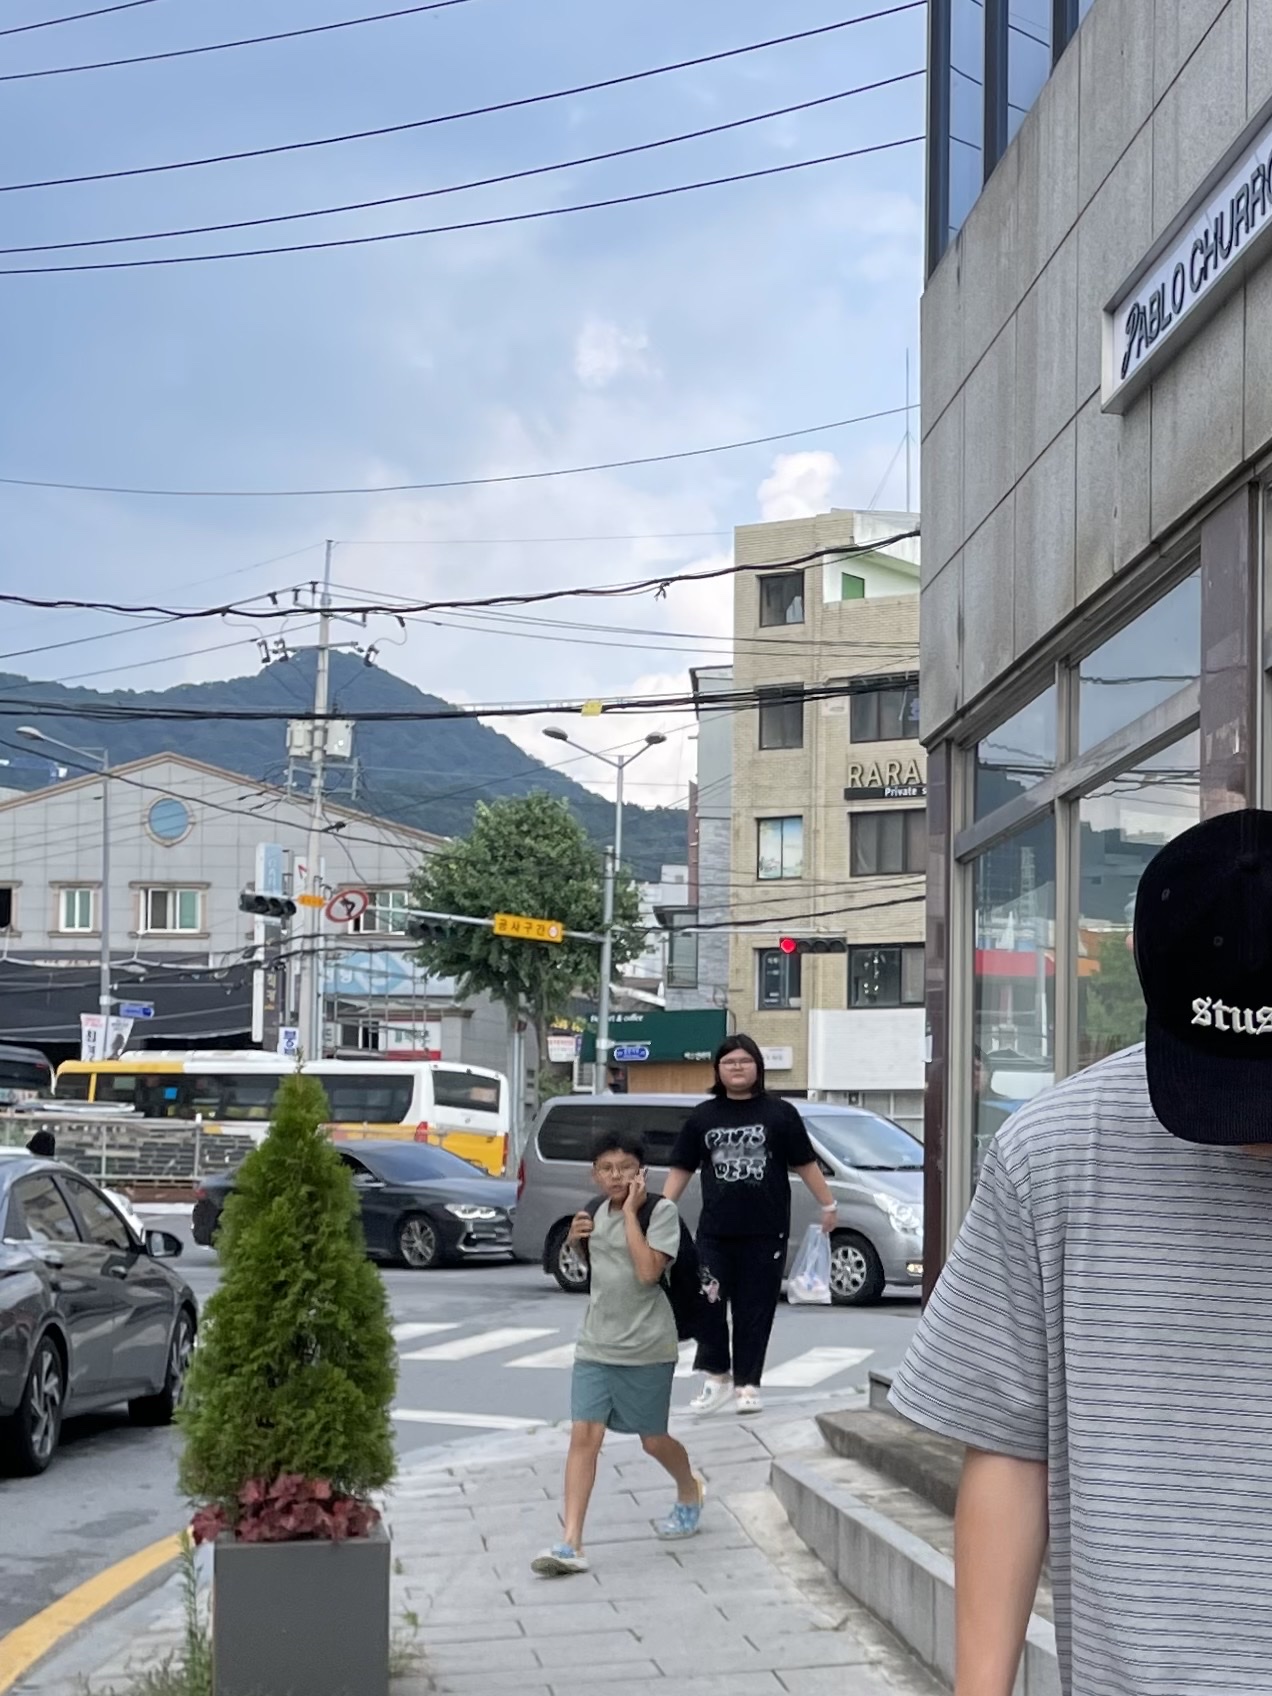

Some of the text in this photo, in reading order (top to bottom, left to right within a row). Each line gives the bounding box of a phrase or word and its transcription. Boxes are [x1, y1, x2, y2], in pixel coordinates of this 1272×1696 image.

[1120, 262, 1185, 380] PABLO
[847, 759, 923, 788] RARA
[885, 786, 917, 797] Private
